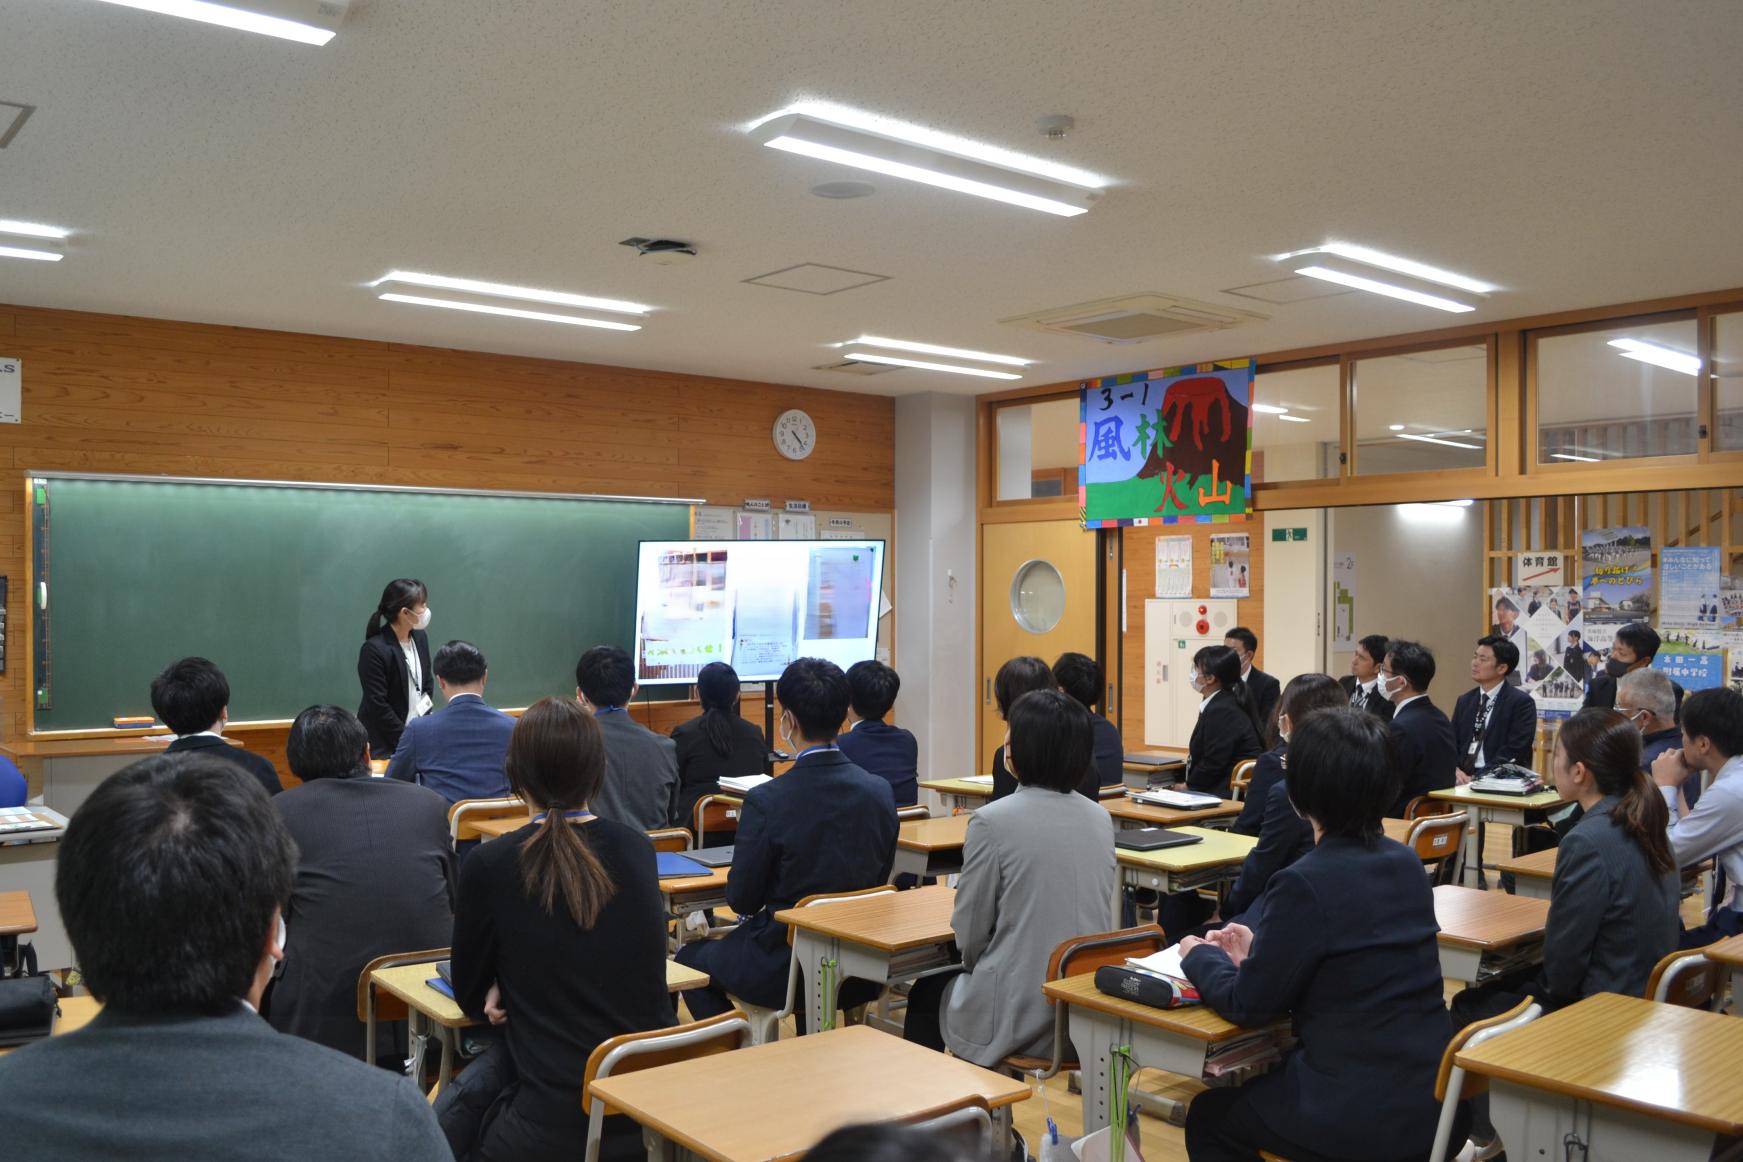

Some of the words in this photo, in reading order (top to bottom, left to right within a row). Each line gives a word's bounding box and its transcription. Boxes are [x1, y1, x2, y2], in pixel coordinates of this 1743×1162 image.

[1099, 382, 1149, 411] 3-1
[1088, 409, 1174, 462] 風林
[1153, 458, 1232, 512] 火山
[1523, 556, 1558, 567] 体育館
